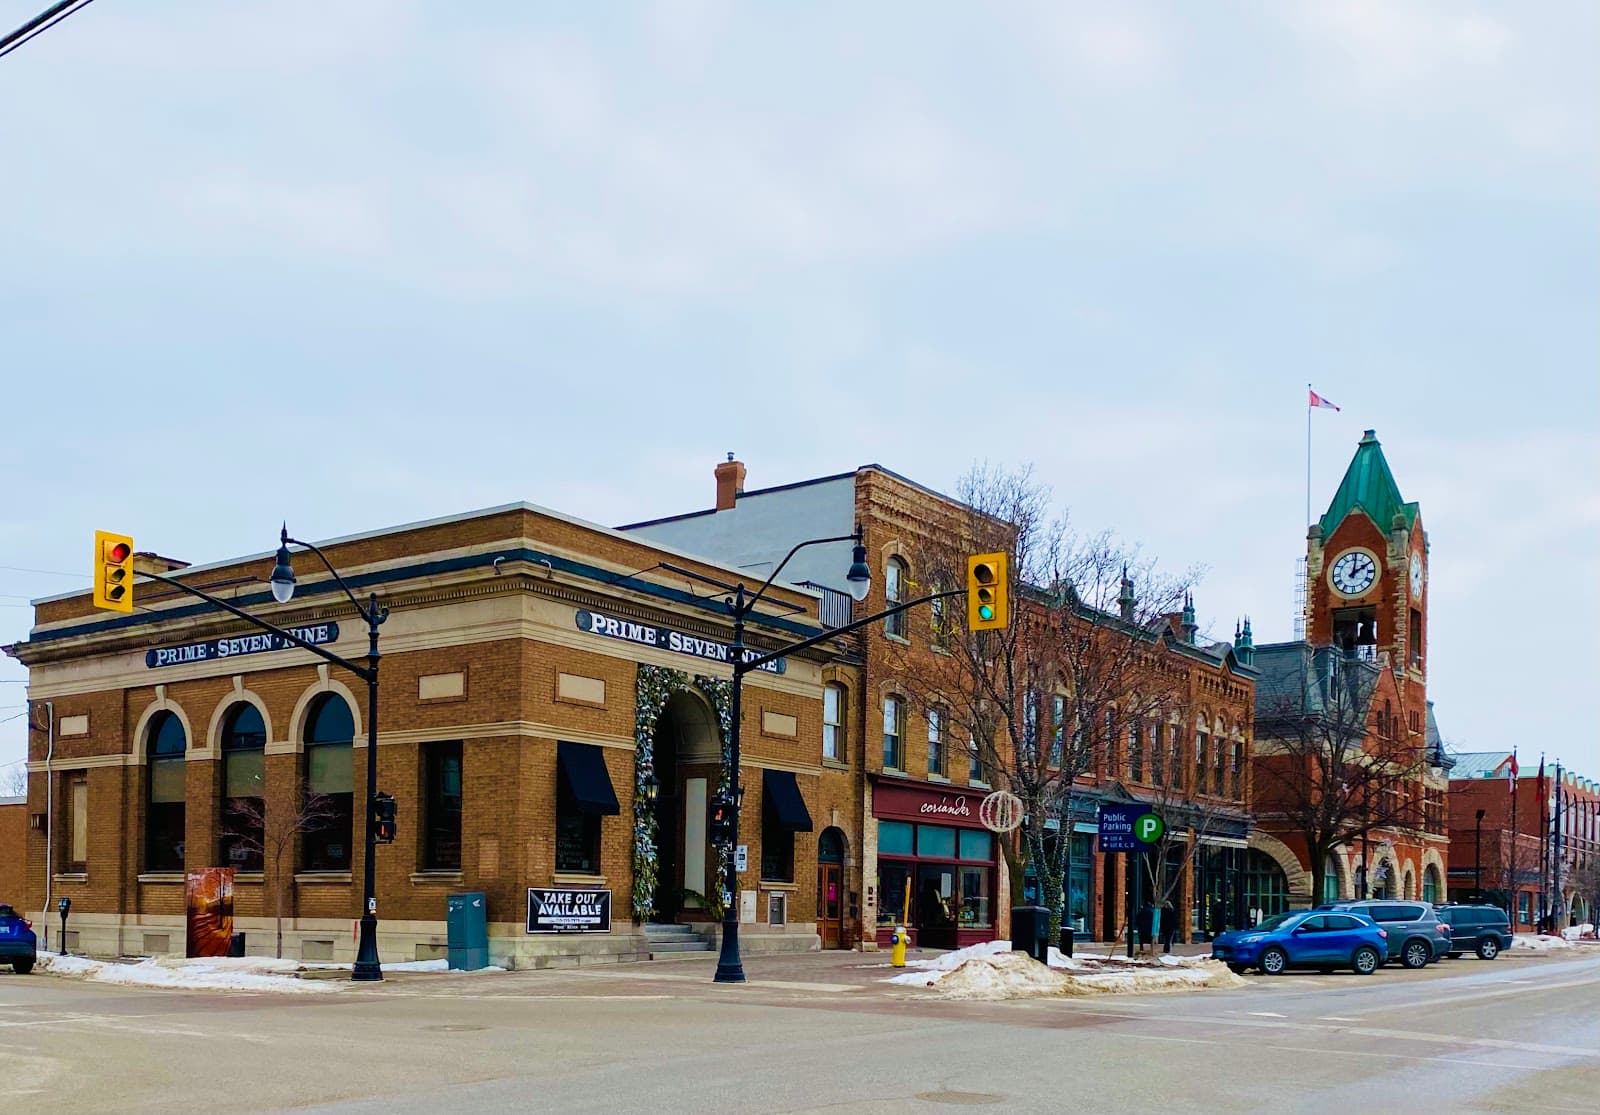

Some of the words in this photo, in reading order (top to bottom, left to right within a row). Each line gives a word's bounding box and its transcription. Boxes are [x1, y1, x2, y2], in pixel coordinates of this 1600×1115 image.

[589, 612, 657, 645] PRIME
[669, 631, 728, 661] SEVEN
[155, 643, 207, 667] PRIME
[217, 633, 273, 657] SEVEN
[282, 625, 328, 648] NINE
[920, 796, 970, 816] coriander
[1103, 813, 1126, 821] Public
[1103, 822, 1132, 833] Parking
[1143, 818, 1157, 838] P
[543, 892, 572, 904] TAKE
[575, 893, 597, 904] OUT
[538, 903, 602, 915] AVAILABLE
